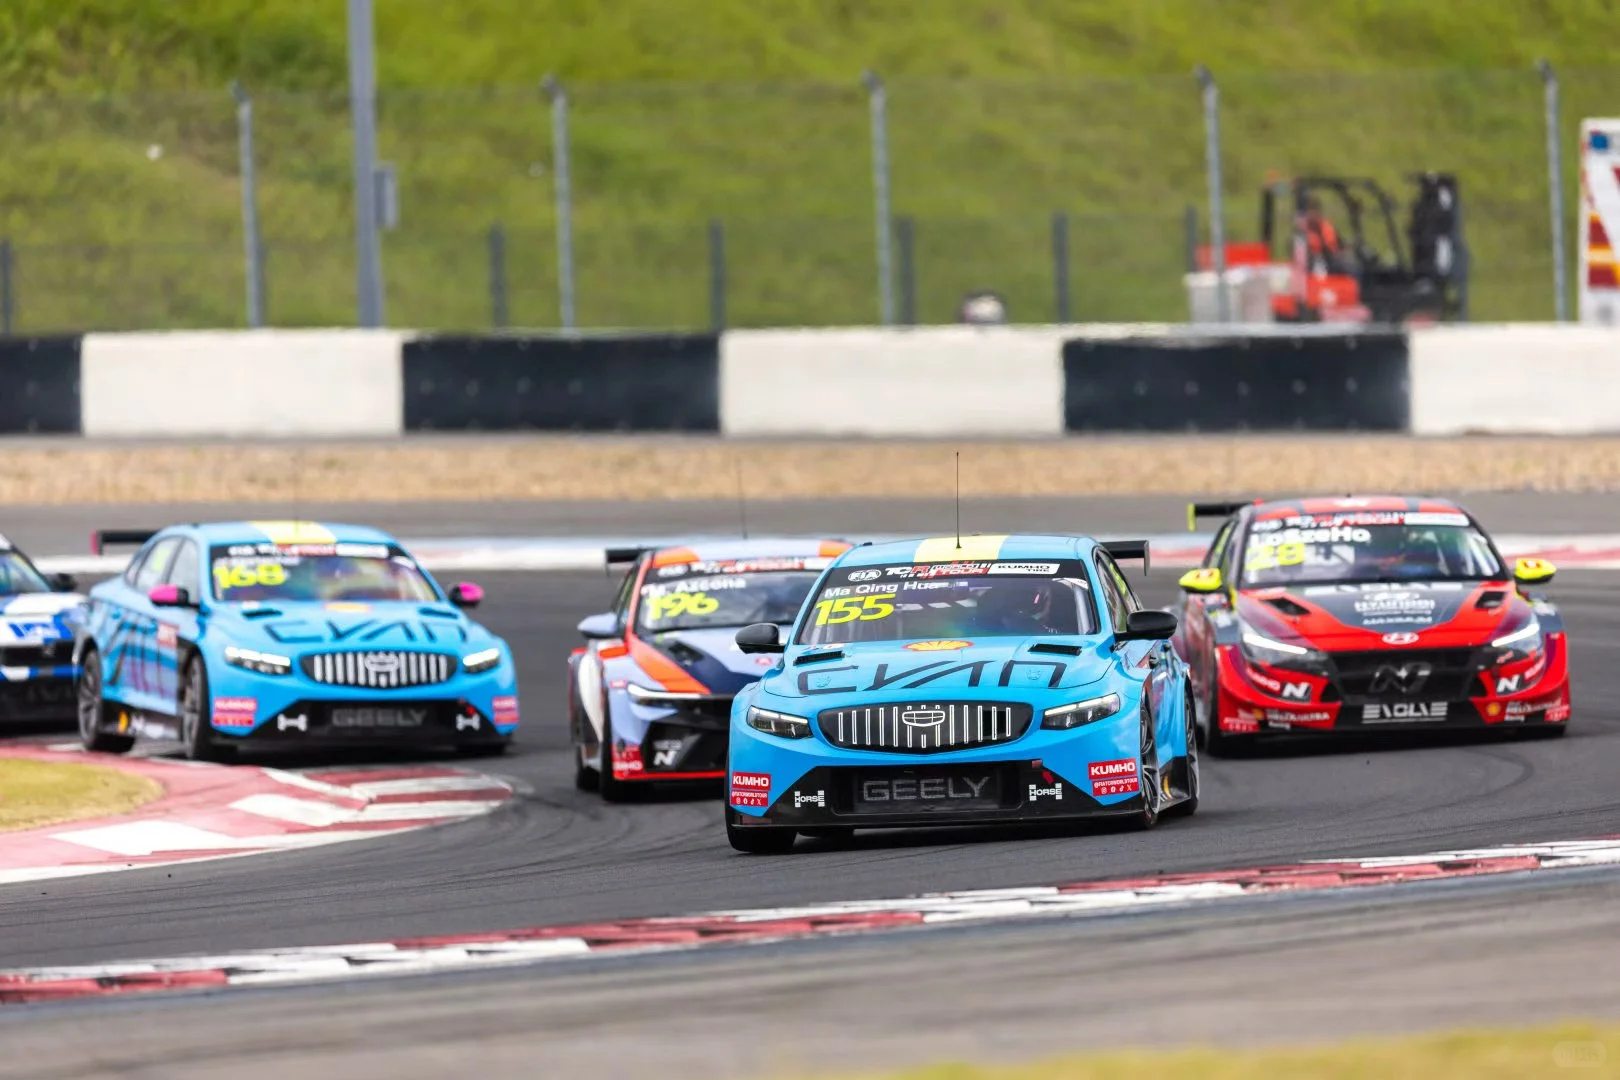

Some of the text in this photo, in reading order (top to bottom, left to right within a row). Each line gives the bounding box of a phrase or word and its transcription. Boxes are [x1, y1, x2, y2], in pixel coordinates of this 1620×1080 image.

[213, 564, 286, 588] 168
[824, 588, 850, 598] Ma
[855, 583, 898, 594] Qing
[646, 592, 719, 620] 196
[815, 593, 895, 626] 155
[332, 708, 427, 727] GEELY
[1090, 762, 1136, 776] KUMHO
[733, 775, 770, 787] KUMHO
[863, 776, 990, 801] GEELY
